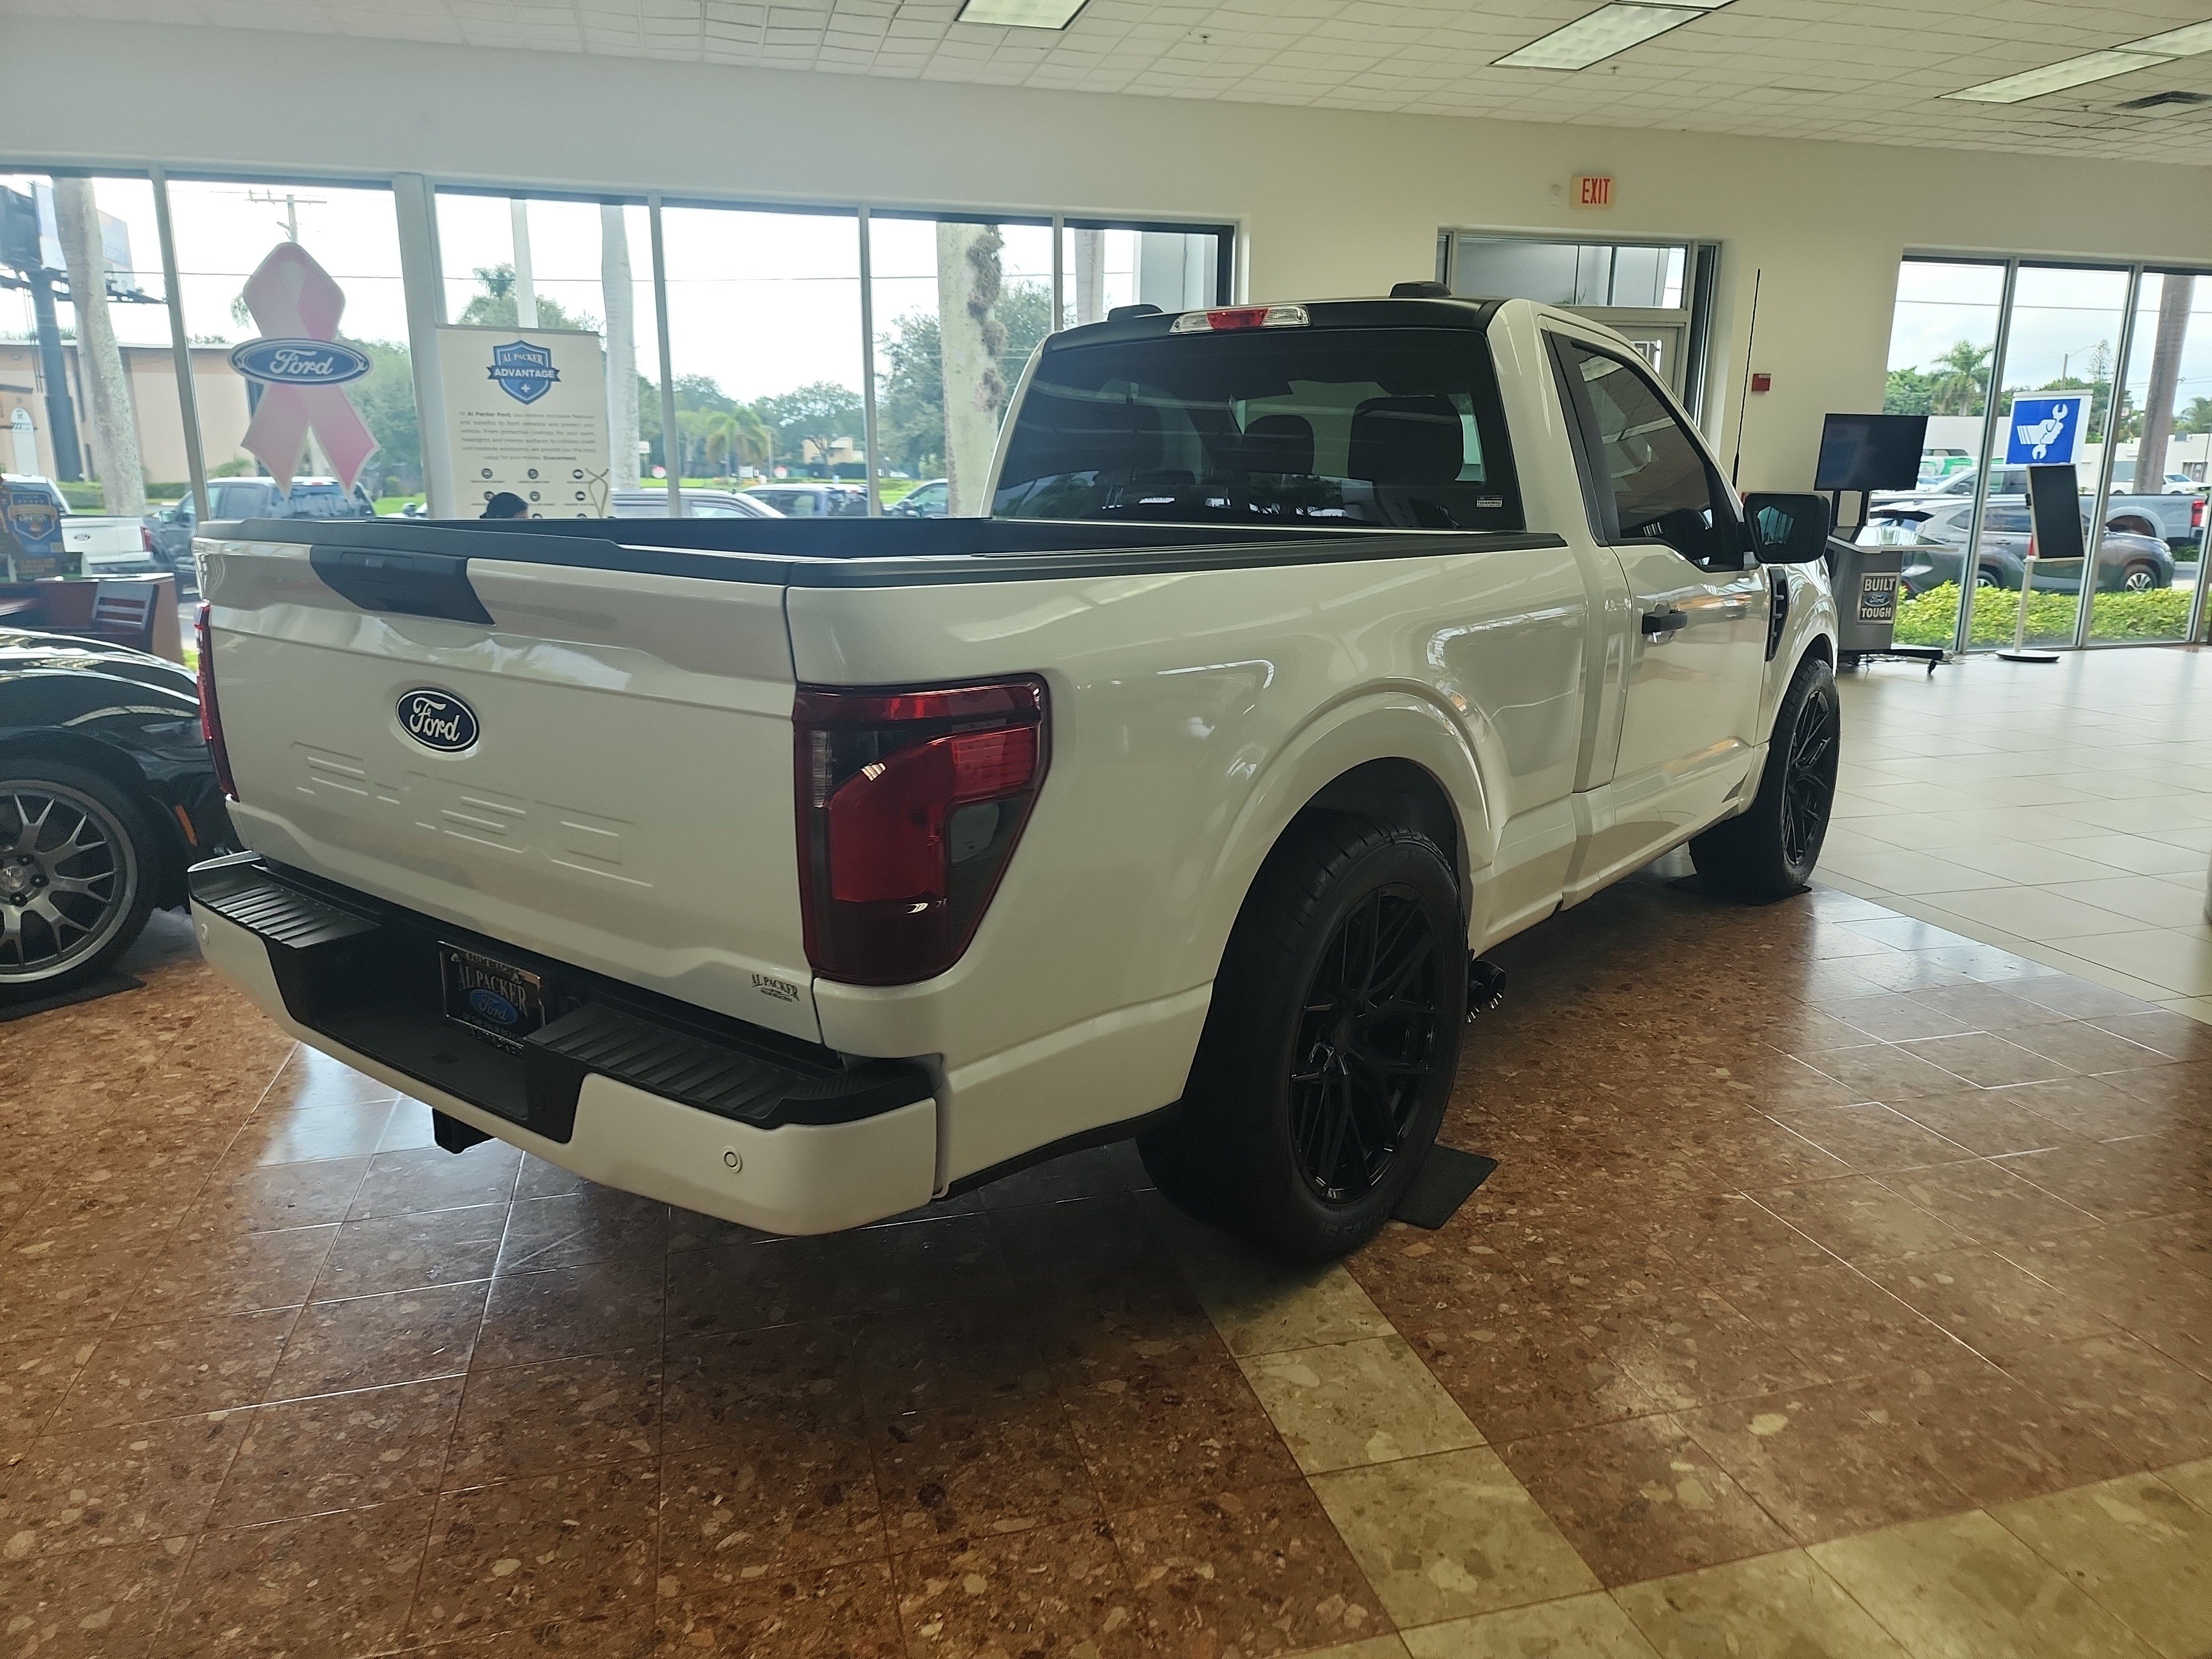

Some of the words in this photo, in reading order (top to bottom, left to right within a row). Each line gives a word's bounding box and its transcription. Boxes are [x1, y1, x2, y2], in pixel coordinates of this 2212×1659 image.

[1582, 178, 1610, 204] EXIT
[269, 348, 334, 377] Ford
[502, 353, 512, 363] AL
[515, 353, 544, 364] PACKER
[494, 368, 555, 378] ADVANTAGE
[1864, 577, 1896, 592] BUILT
[1861, 607, 1892, 618] TOUGH
[409, 697, 460, 742] Ford
[458, 963, 475, 992] AL
[476, 969, 528, 1018] PACKER
[752, 974, 763, 988] AL
[764, 976, 800, 1001] PACKER
[478, 994, 507, 1021] Ford
